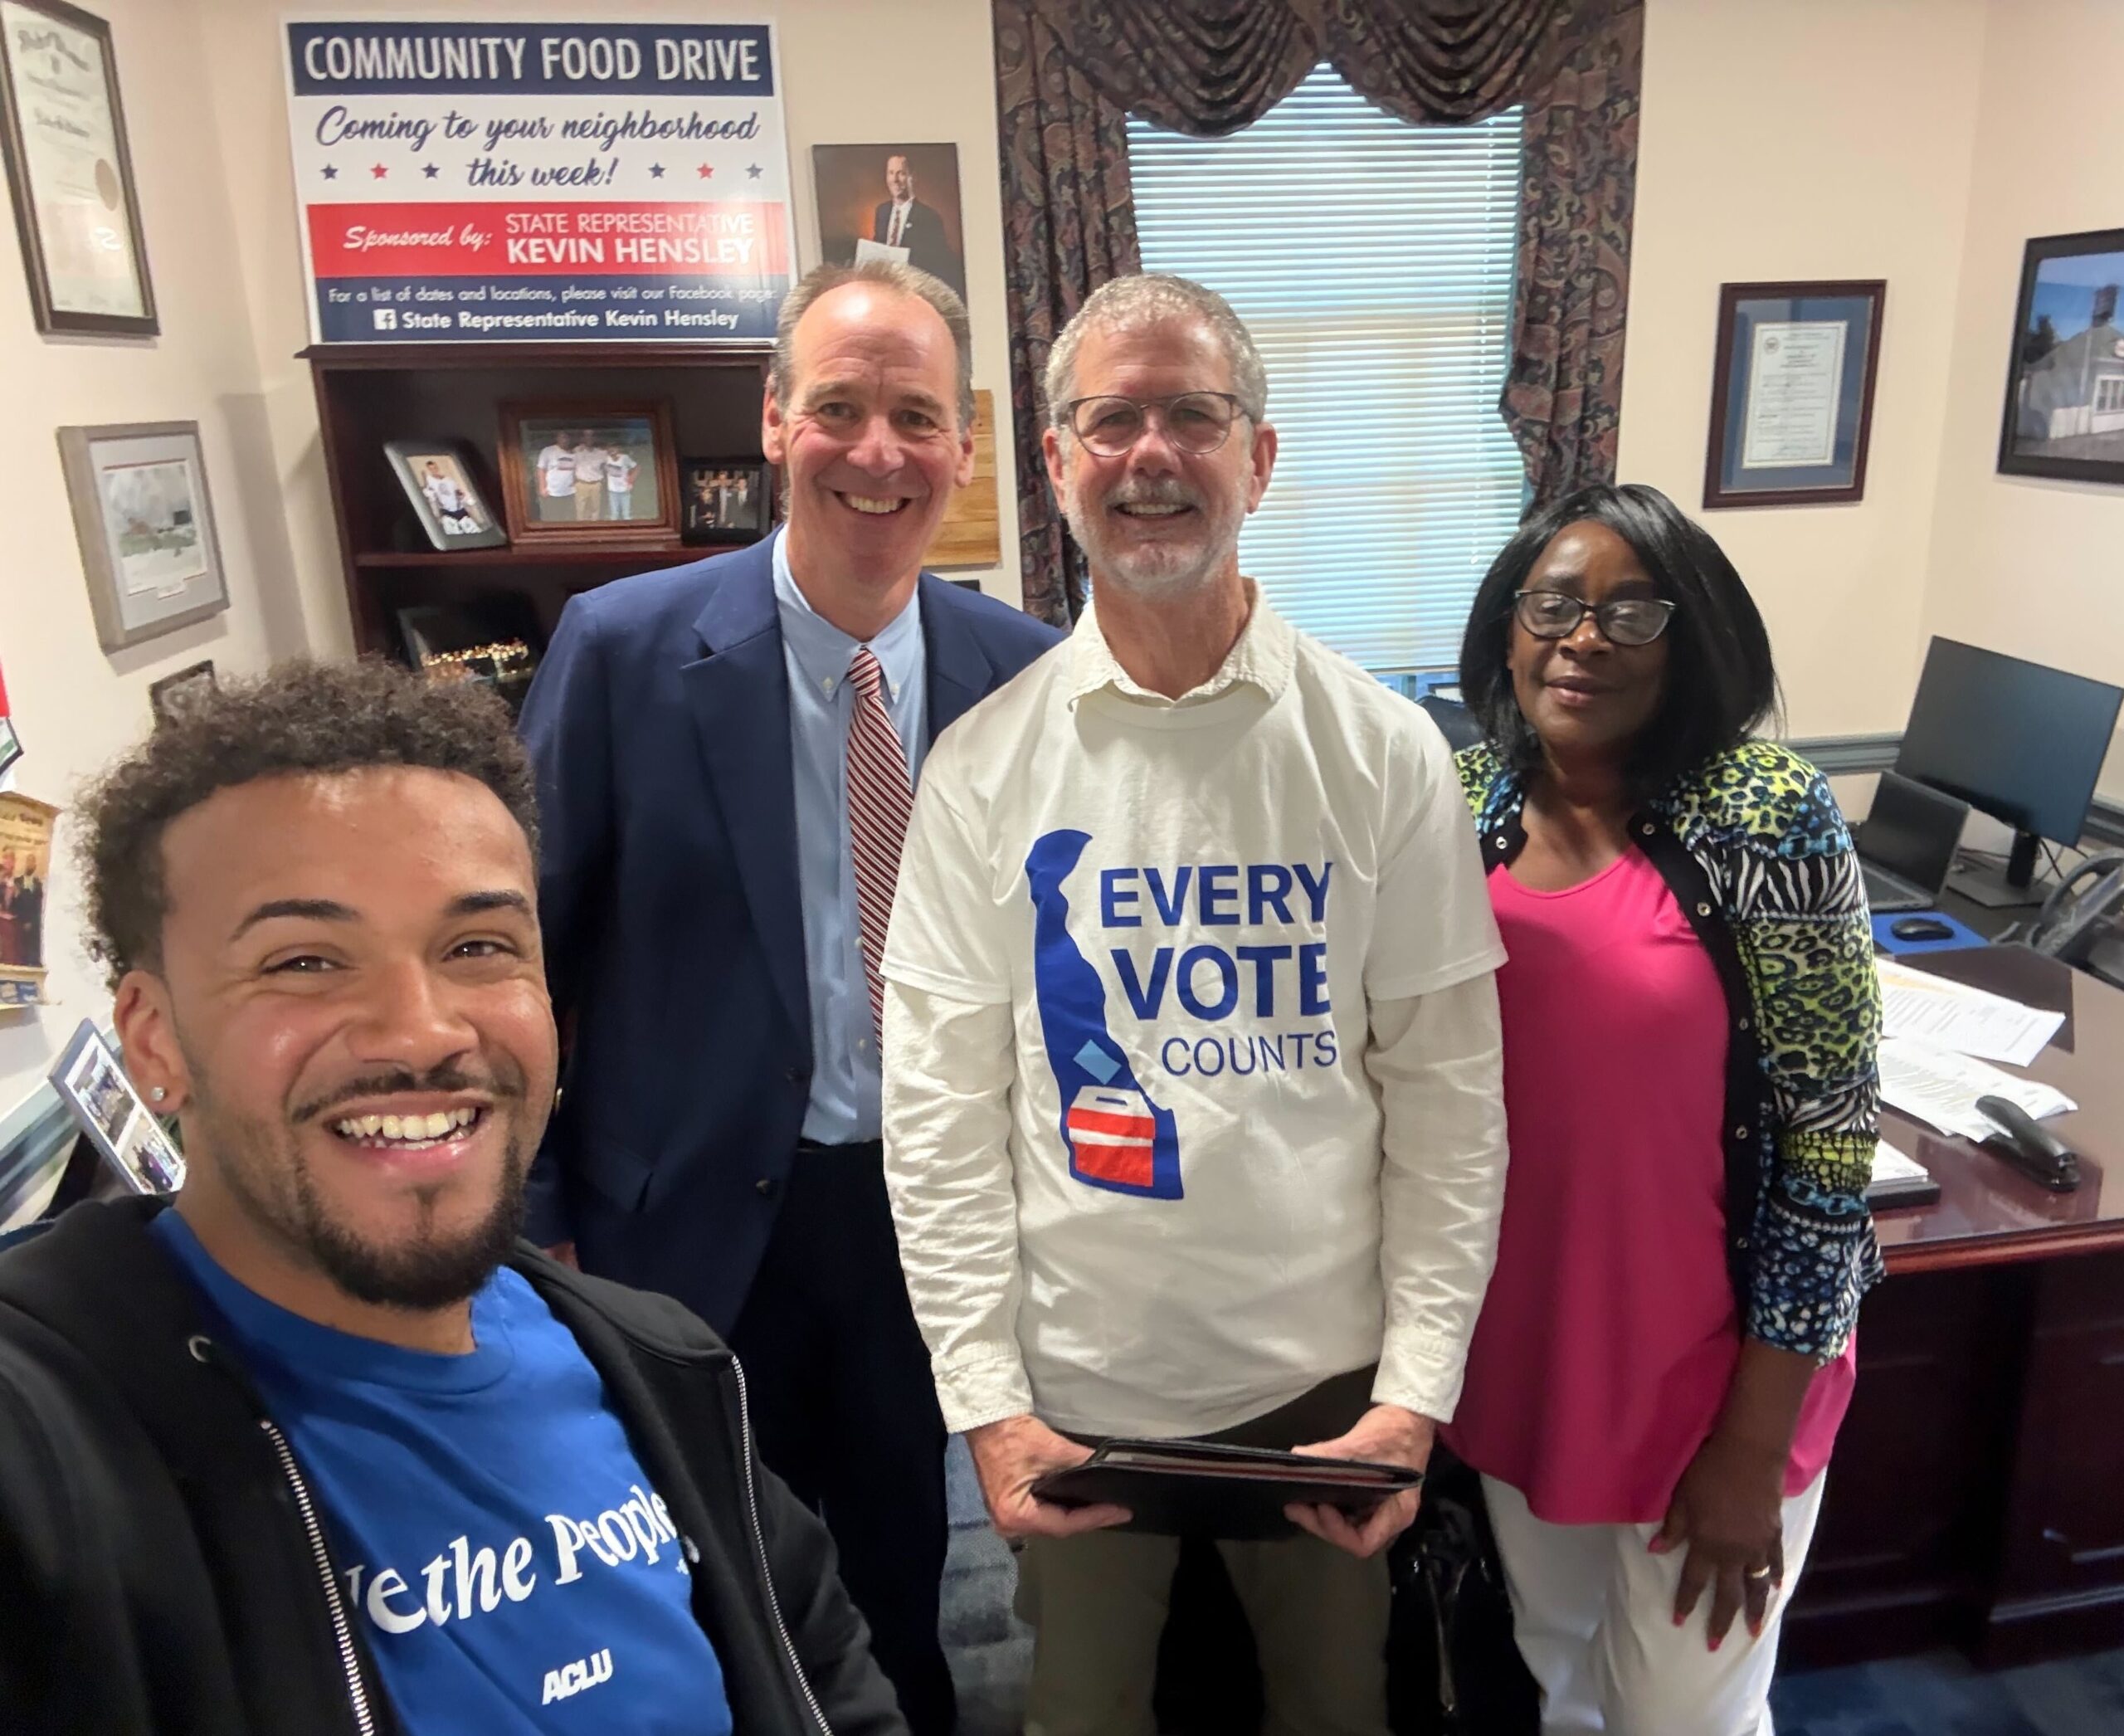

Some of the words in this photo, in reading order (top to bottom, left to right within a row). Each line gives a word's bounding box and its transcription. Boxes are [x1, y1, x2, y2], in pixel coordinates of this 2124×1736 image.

[304, 37, 526, 80] COMMUNITY
[541, 37, 642, 80] FOOD
[655, 38, 761, 81] DRIVE
[315, 105, 437, 152] Coming
[442, 110, 479, 139] to
[483, 116, 555, 152] your
[561, 110, 761, 152] neighborhood
[465, 158, 524, 187] this
[530, 157, 620, 187] week!
[343, 225, 455, 252] Sponsored
[458, 222, 494, 252] by:
[504, 213, 569, 234] STATE
[577, 212, 755, 235] REPRESENTATIVE
[506, 237, 605, 264] KEVIN
[614, 237, 755, 265] HENSLEY
[329, 288, 351, 303] For
[356, 290, 368, 303] a
[371, 287, 392, 302] list
[395, 285, 412, 302] of
[415, 285, 455, 301] dates
[458, 285, 486, 301] and
[490, 285, 557, 304] locations,
[561, 284, 607, 304] please
[610, 285, 637, 300] visit
[641, 288, 665, 300] our
[669, 285, 733, 300] Facebook
[402, 311, 452, 329] State
[458, 310, 599, 332] Representative
[604, 309, 658, 327] Kevin
[664, 309, 739, 329] Hensley
[1100, 861, 1334, 929] EVERY
[1110, 943, 1332, 1021] VOTE
[1161, 1029, 1338, 1077] COUNTS
[421, 1535, 537, 1627] the
[544, 1484, 677, 1586] People
[541, 1648, 613, 1706] ACLU
